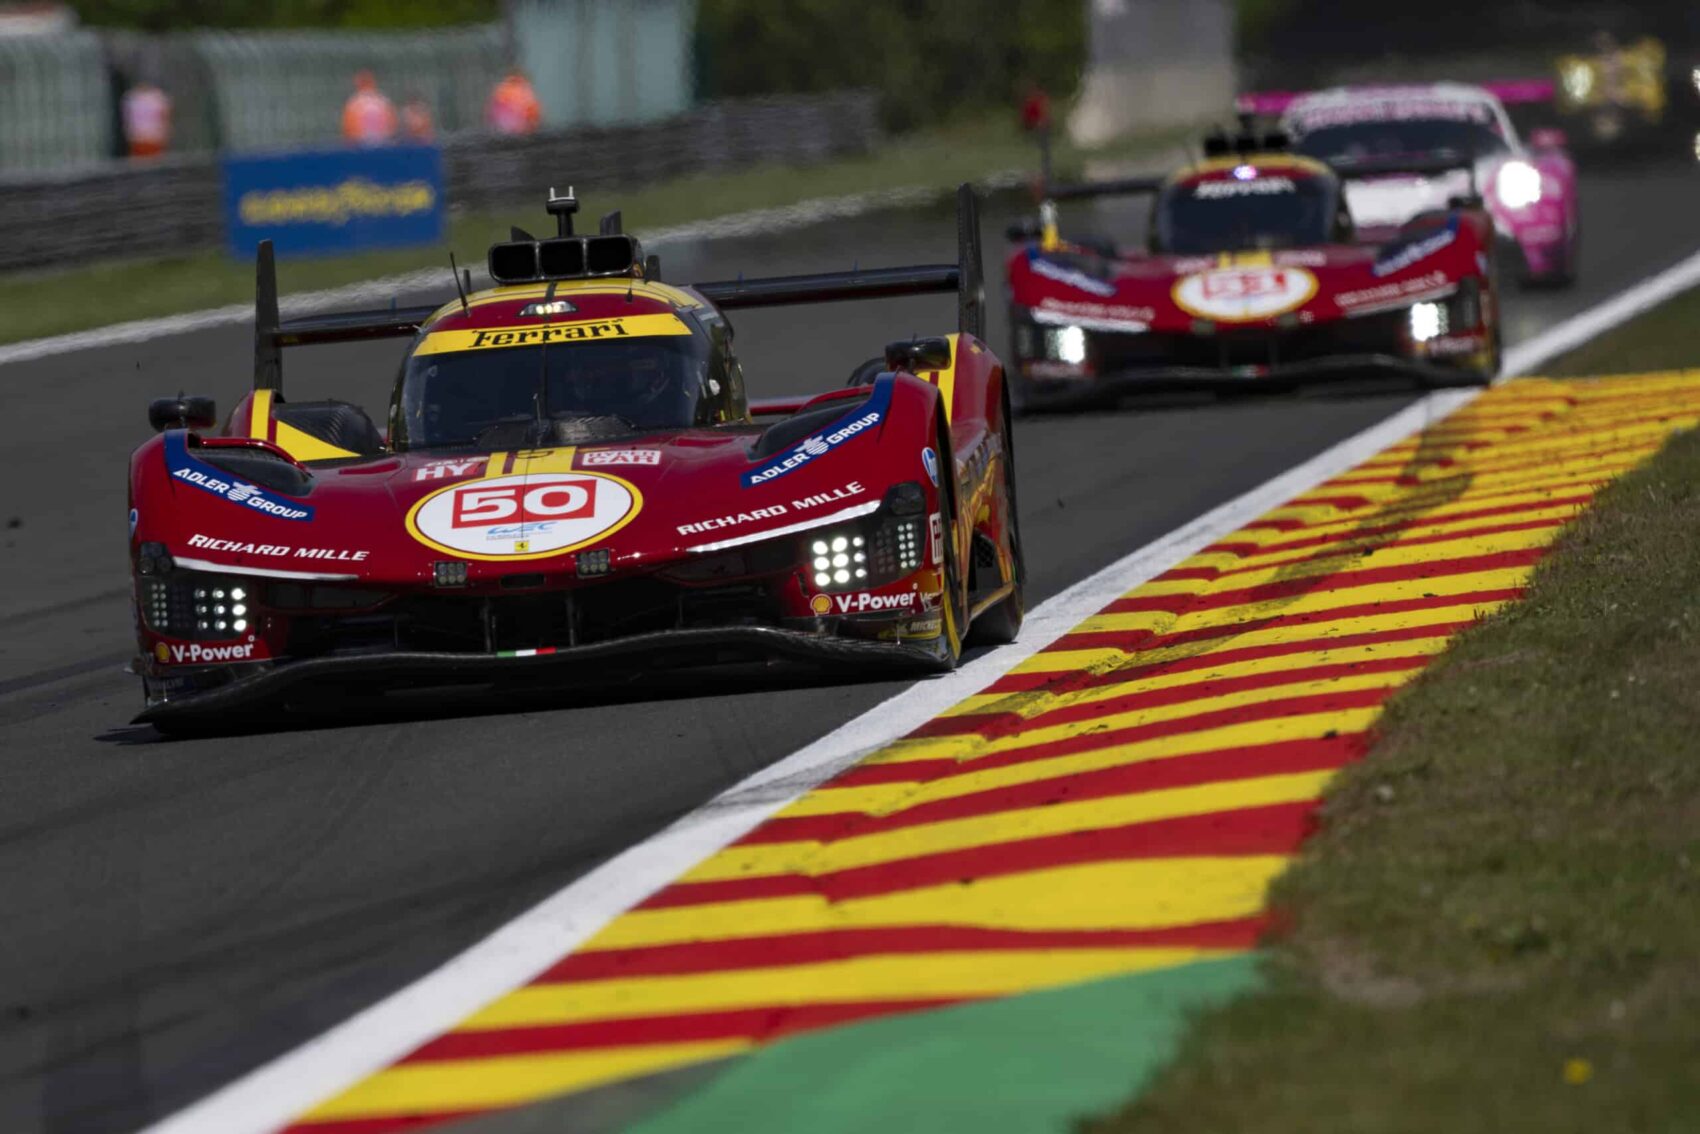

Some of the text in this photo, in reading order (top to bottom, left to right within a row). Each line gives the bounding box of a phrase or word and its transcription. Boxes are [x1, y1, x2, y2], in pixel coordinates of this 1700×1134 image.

[468, 318, 629, 348] Ferrari
[750, 411, 881, 485] ADLER GROUP
[173, 468, 307, 520] ADLER GROUP
[460, 485, 588, 522] 50
[676, 481, 866, 536] RICHARD MILLE
[187, 534, 370, 561] RICHARD MILLE
[836, 591, 917, 614] V-Power
[171, 642, 254, 663] V-Power
